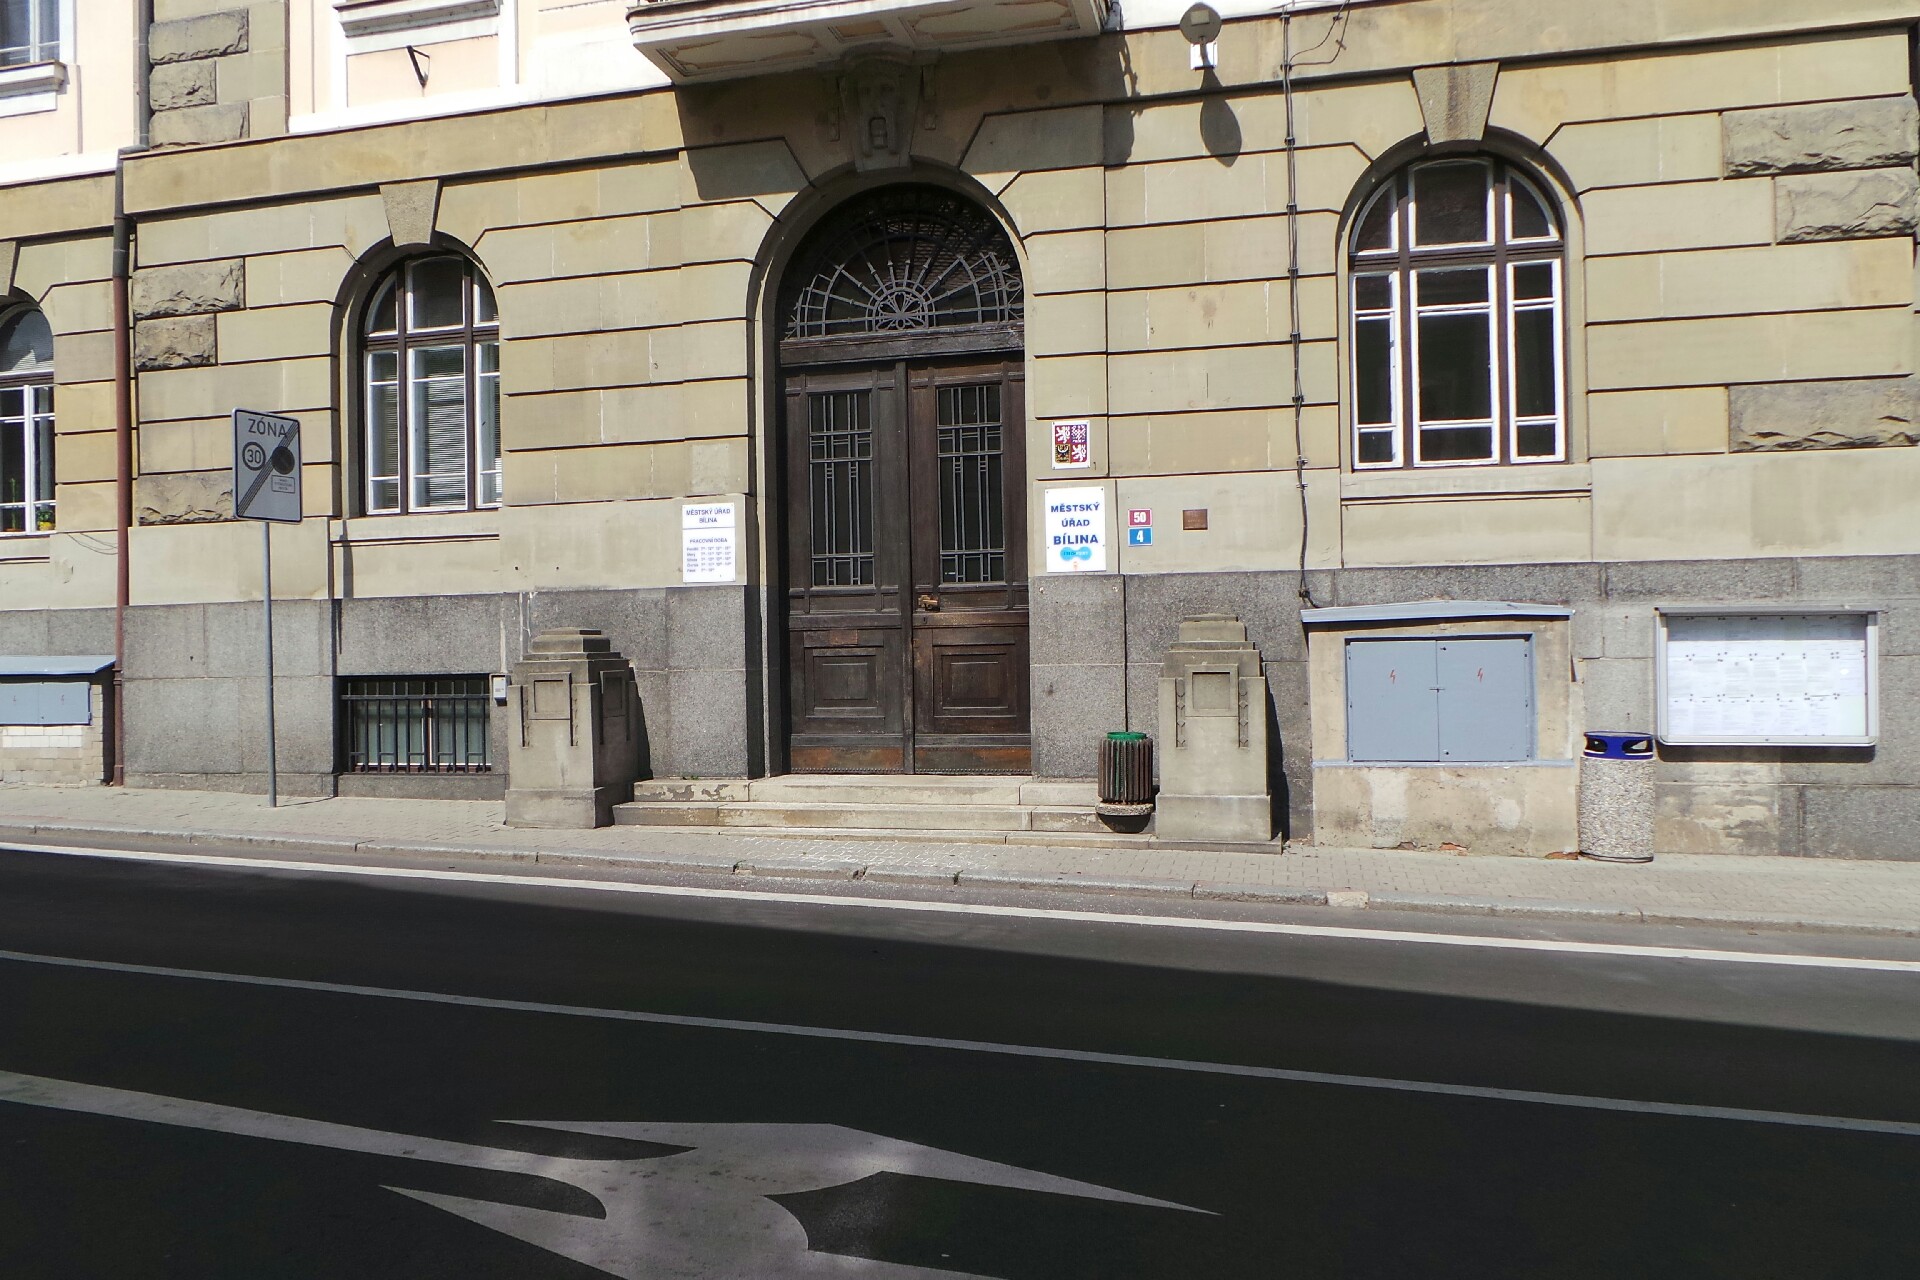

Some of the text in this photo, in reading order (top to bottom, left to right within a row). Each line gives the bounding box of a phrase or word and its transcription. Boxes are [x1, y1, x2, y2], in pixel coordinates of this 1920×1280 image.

[248, 417, 288, 438] ZÓNA
[247, 449, 262, 464] 30
[1050, 501, 1100, 512] MĚSTSKÝ
[1061, 517, 1090, 527] ÚŘAD
[1133, 512, 1147, 523] 50
[1053, 533, 1098, 545] BÍLINA
[1136, 530, 1144, 543] 4
